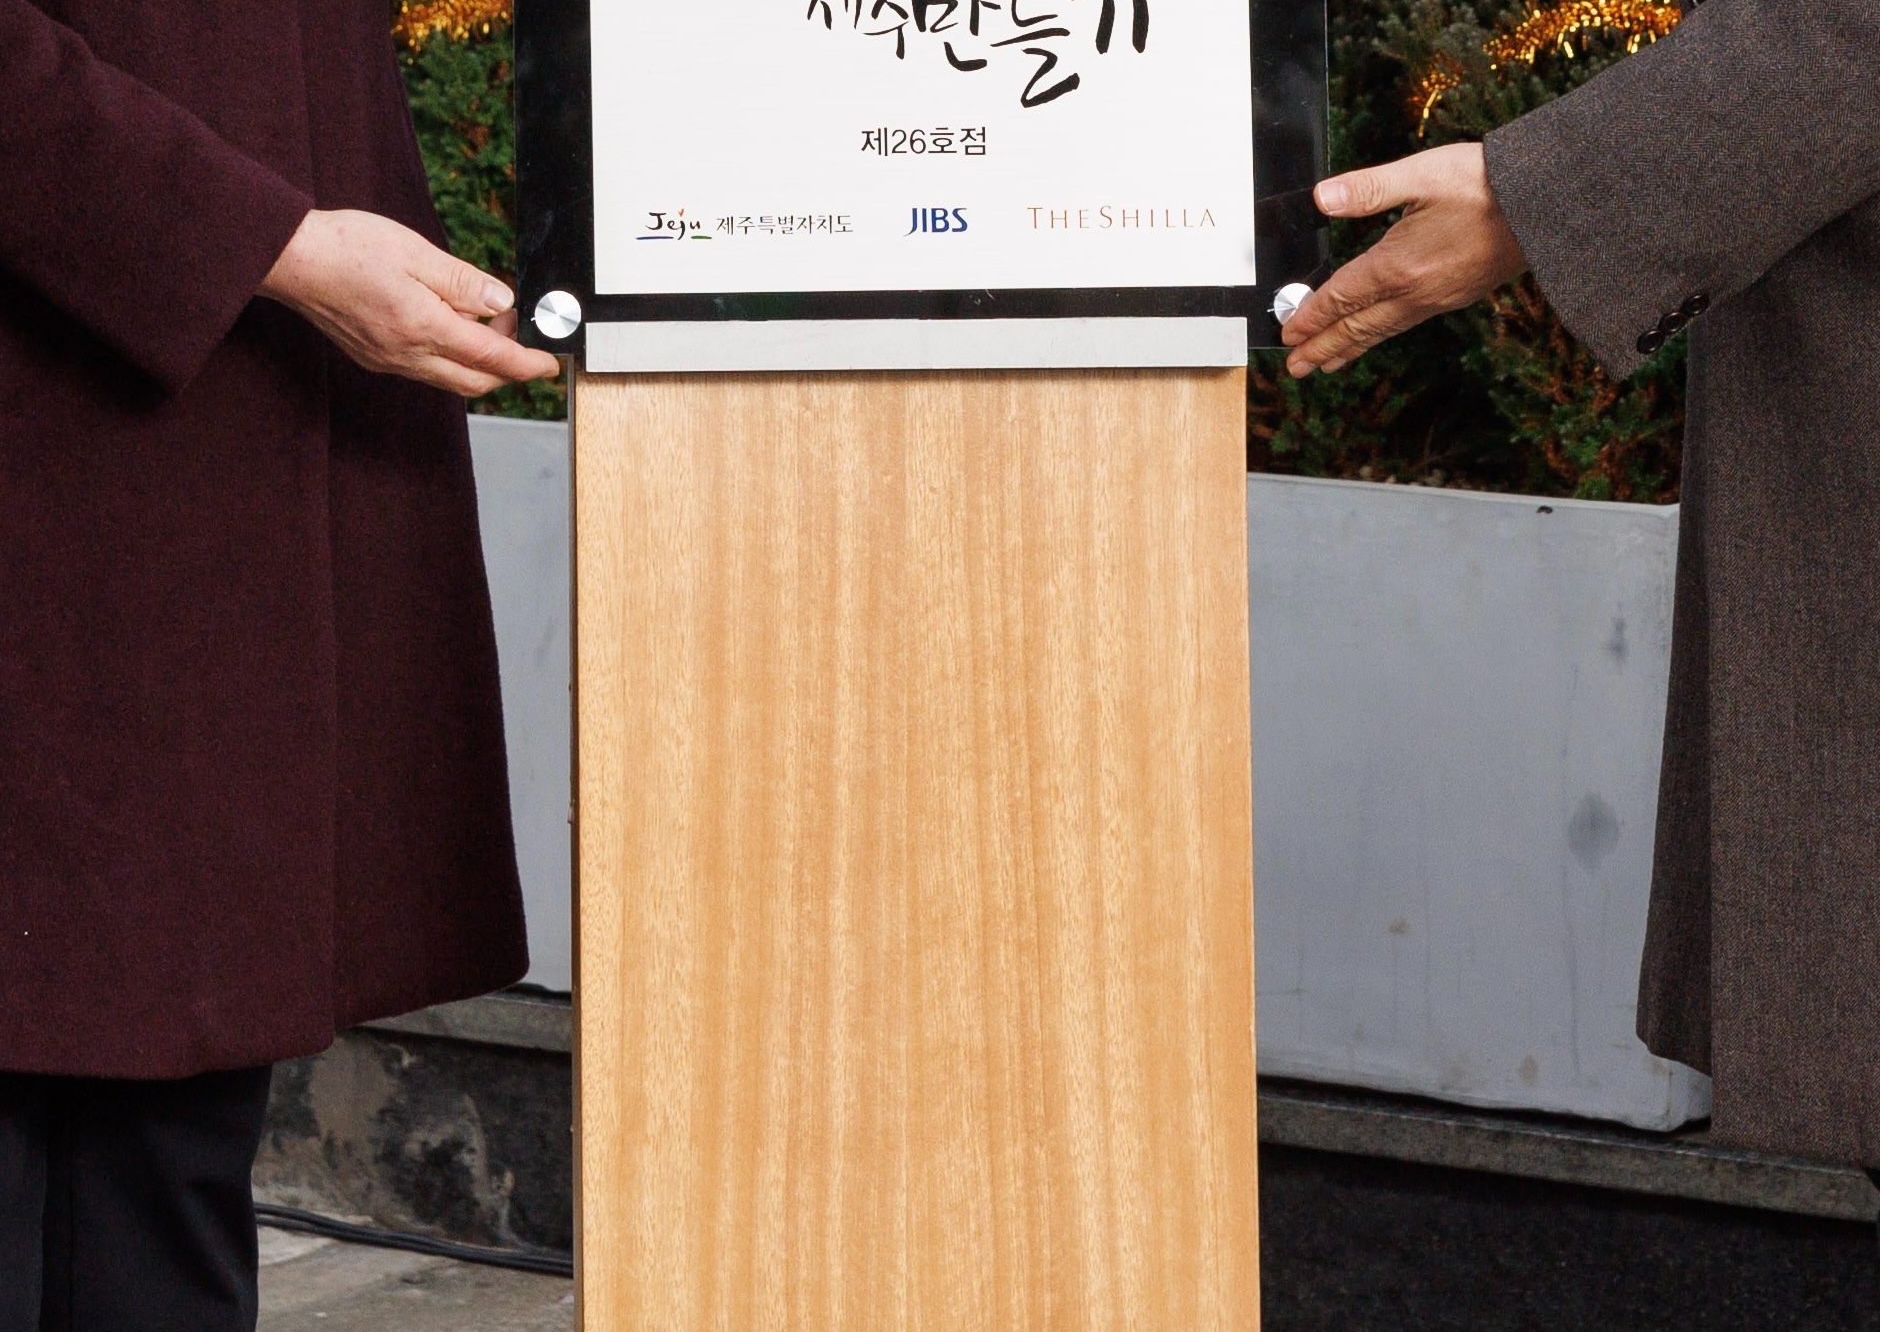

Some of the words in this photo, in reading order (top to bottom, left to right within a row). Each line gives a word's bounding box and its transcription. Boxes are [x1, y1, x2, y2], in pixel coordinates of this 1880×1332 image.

[859, 124, 989, 158] 제26호점
[645, 208, 703, 241] Jeju
[715, 213, 855, 237] 제주특별자치도
[903, 206, 970, 238] JIBS
